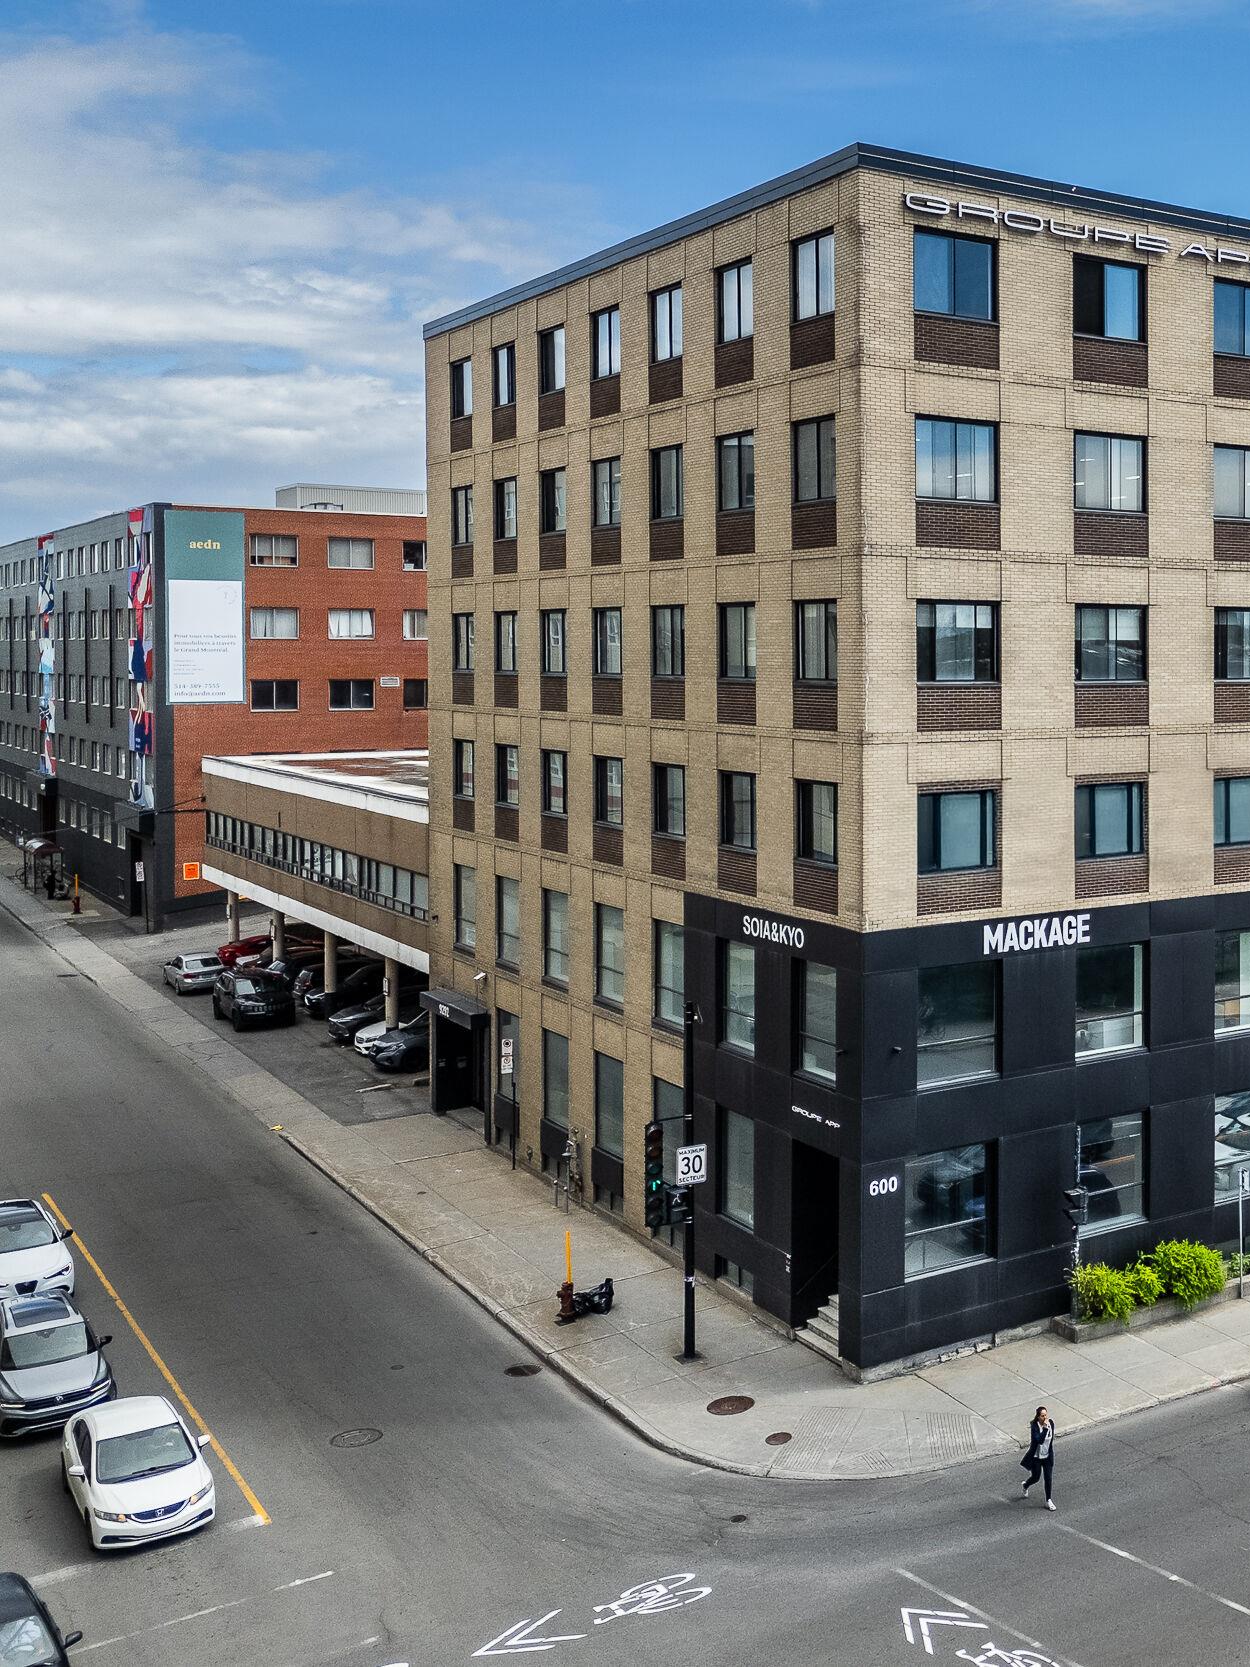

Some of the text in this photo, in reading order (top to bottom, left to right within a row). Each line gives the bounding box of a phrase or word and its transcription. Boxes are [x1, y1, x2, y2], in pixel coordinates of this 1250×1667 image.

[902, 192, 1170, 254] GROUPE
[189, 539, 221, 550] aedn
[742, 915, 804, 949] SOIA&KYO
[983, 913, 1091, 955] MACKAGE
[791, 1105, 841, 1129] GROUPE APP
[678, 1147, 705, 1156] MAXIMUM
[680, 1154, 703, 1176] 30
[678, 1175, 705, 1184] SECTEUR
[869, 1176, 898, 1197] 600
